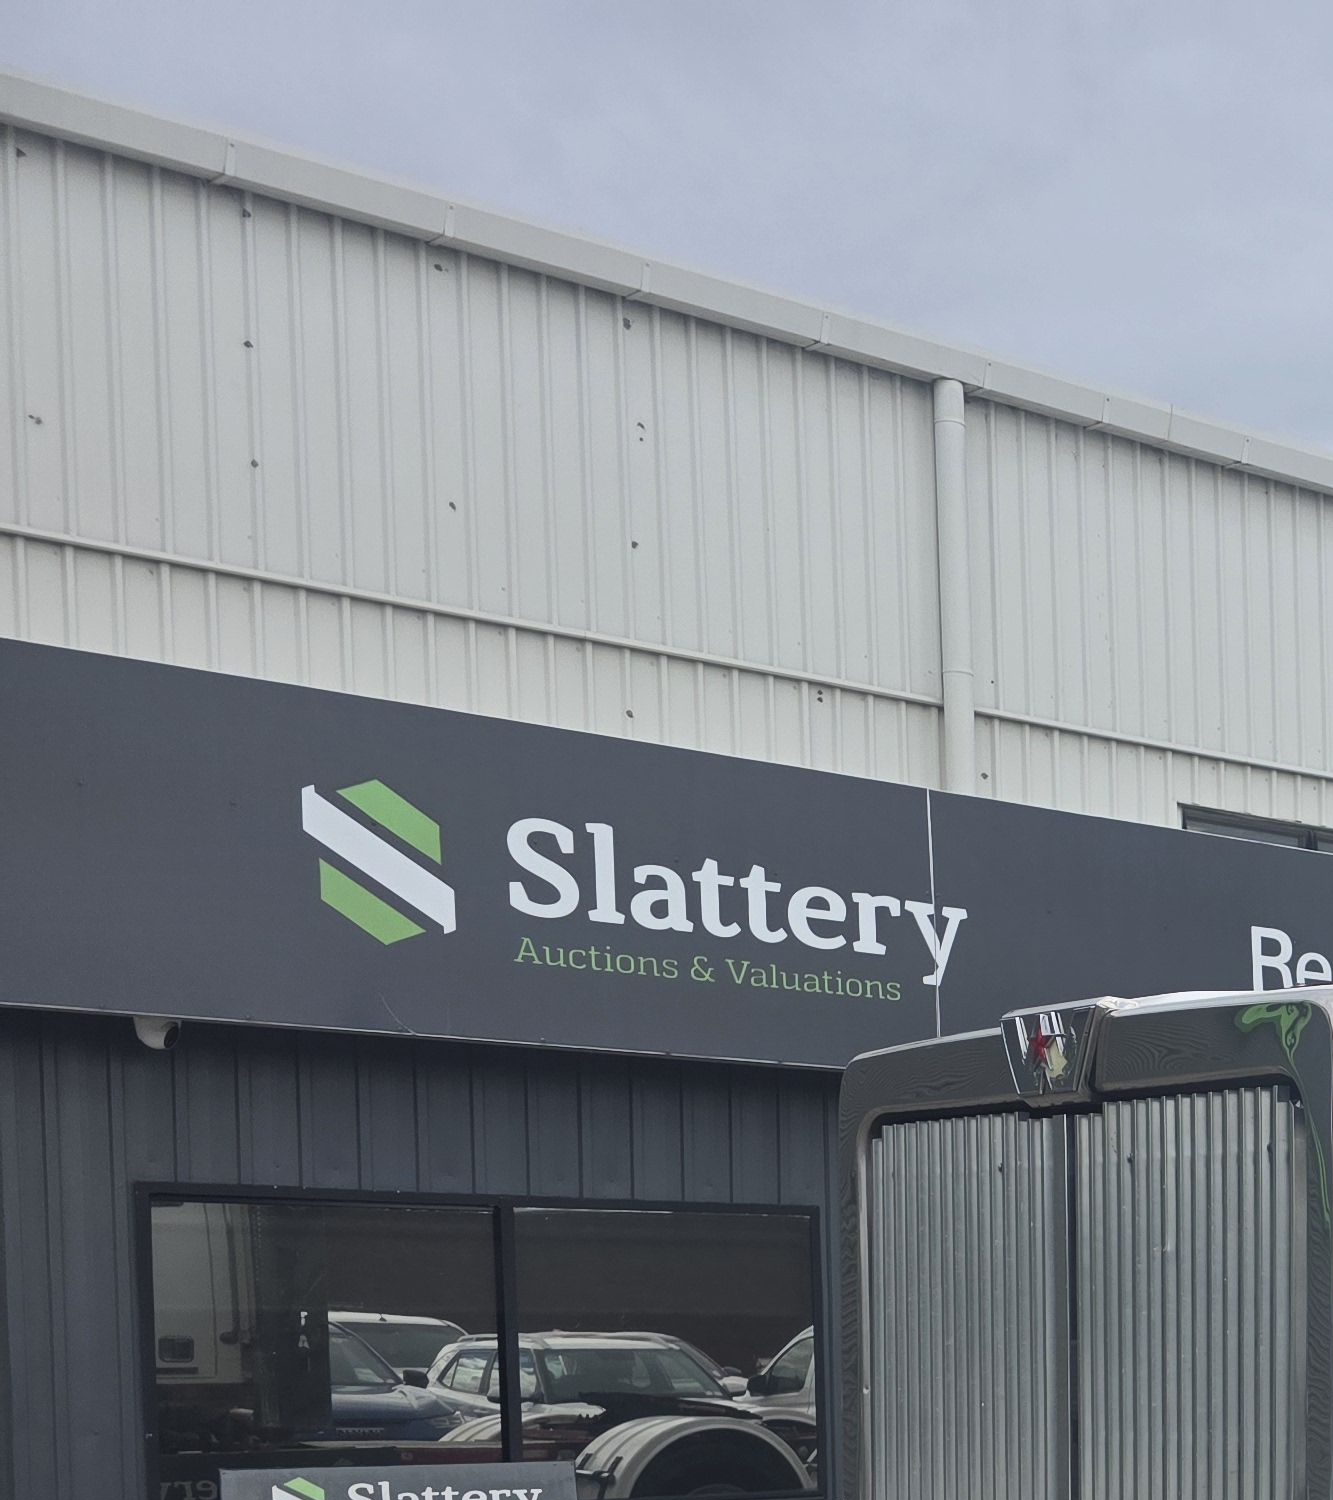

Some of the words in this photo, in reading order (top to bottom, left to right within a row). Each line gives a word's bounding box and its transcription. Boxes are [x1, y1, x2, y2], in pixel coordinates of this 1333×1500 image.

[507, 818, 967, 985] Slattery
[513, 936, 679, 980] Auctions
[690, 956, 715, 982] &
[726, 958, 902, 1000] Valuations
